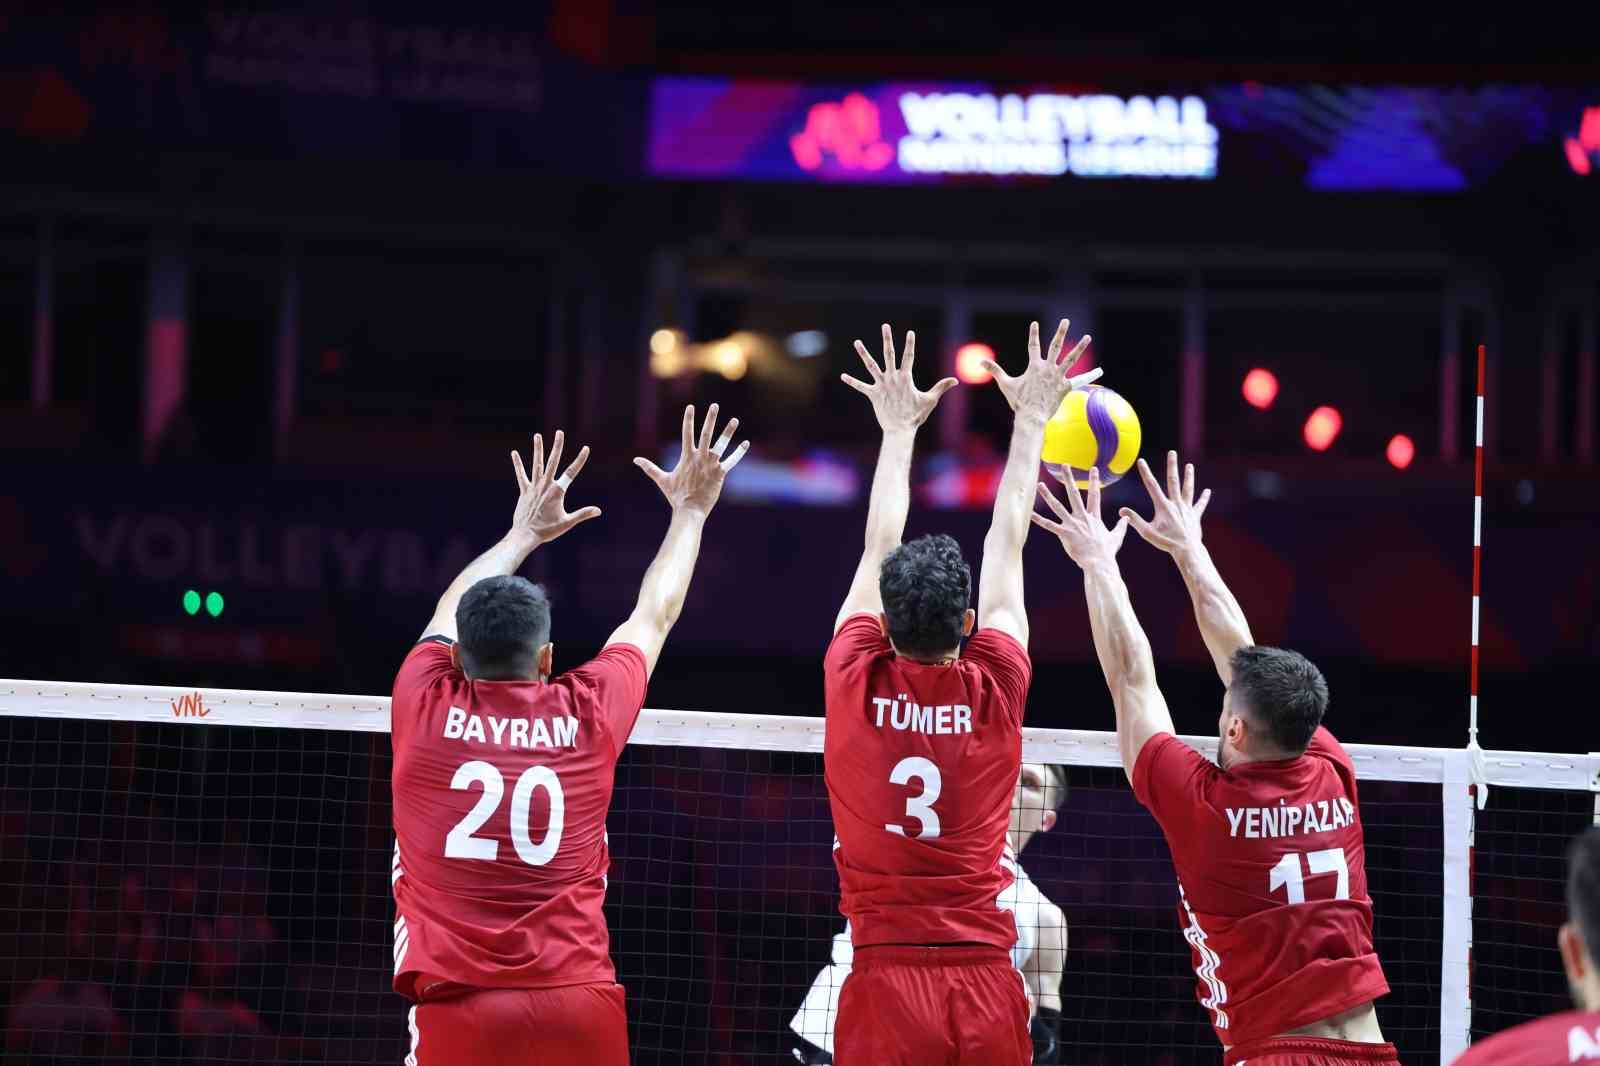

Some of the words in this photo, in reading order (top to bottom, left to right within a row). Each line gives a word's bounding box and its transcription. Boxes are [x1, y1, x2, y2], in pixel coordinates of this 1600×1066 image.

[899, 93, 1218, 142] VOLLEYBALL
[76, 512, 515, 598] VOLLEYBA
[171, 691, 210, 718] VNL
[443, 705, 579, 749] BAYRAM
[872, 693, 973, 735] TÜMER
[444, 760, 565, 866] 20
[884, 756, 942, 839] 3
[1225, 797, 1354, 839] YENİPAZAR
[1269, 847, 1350, 905] 17
